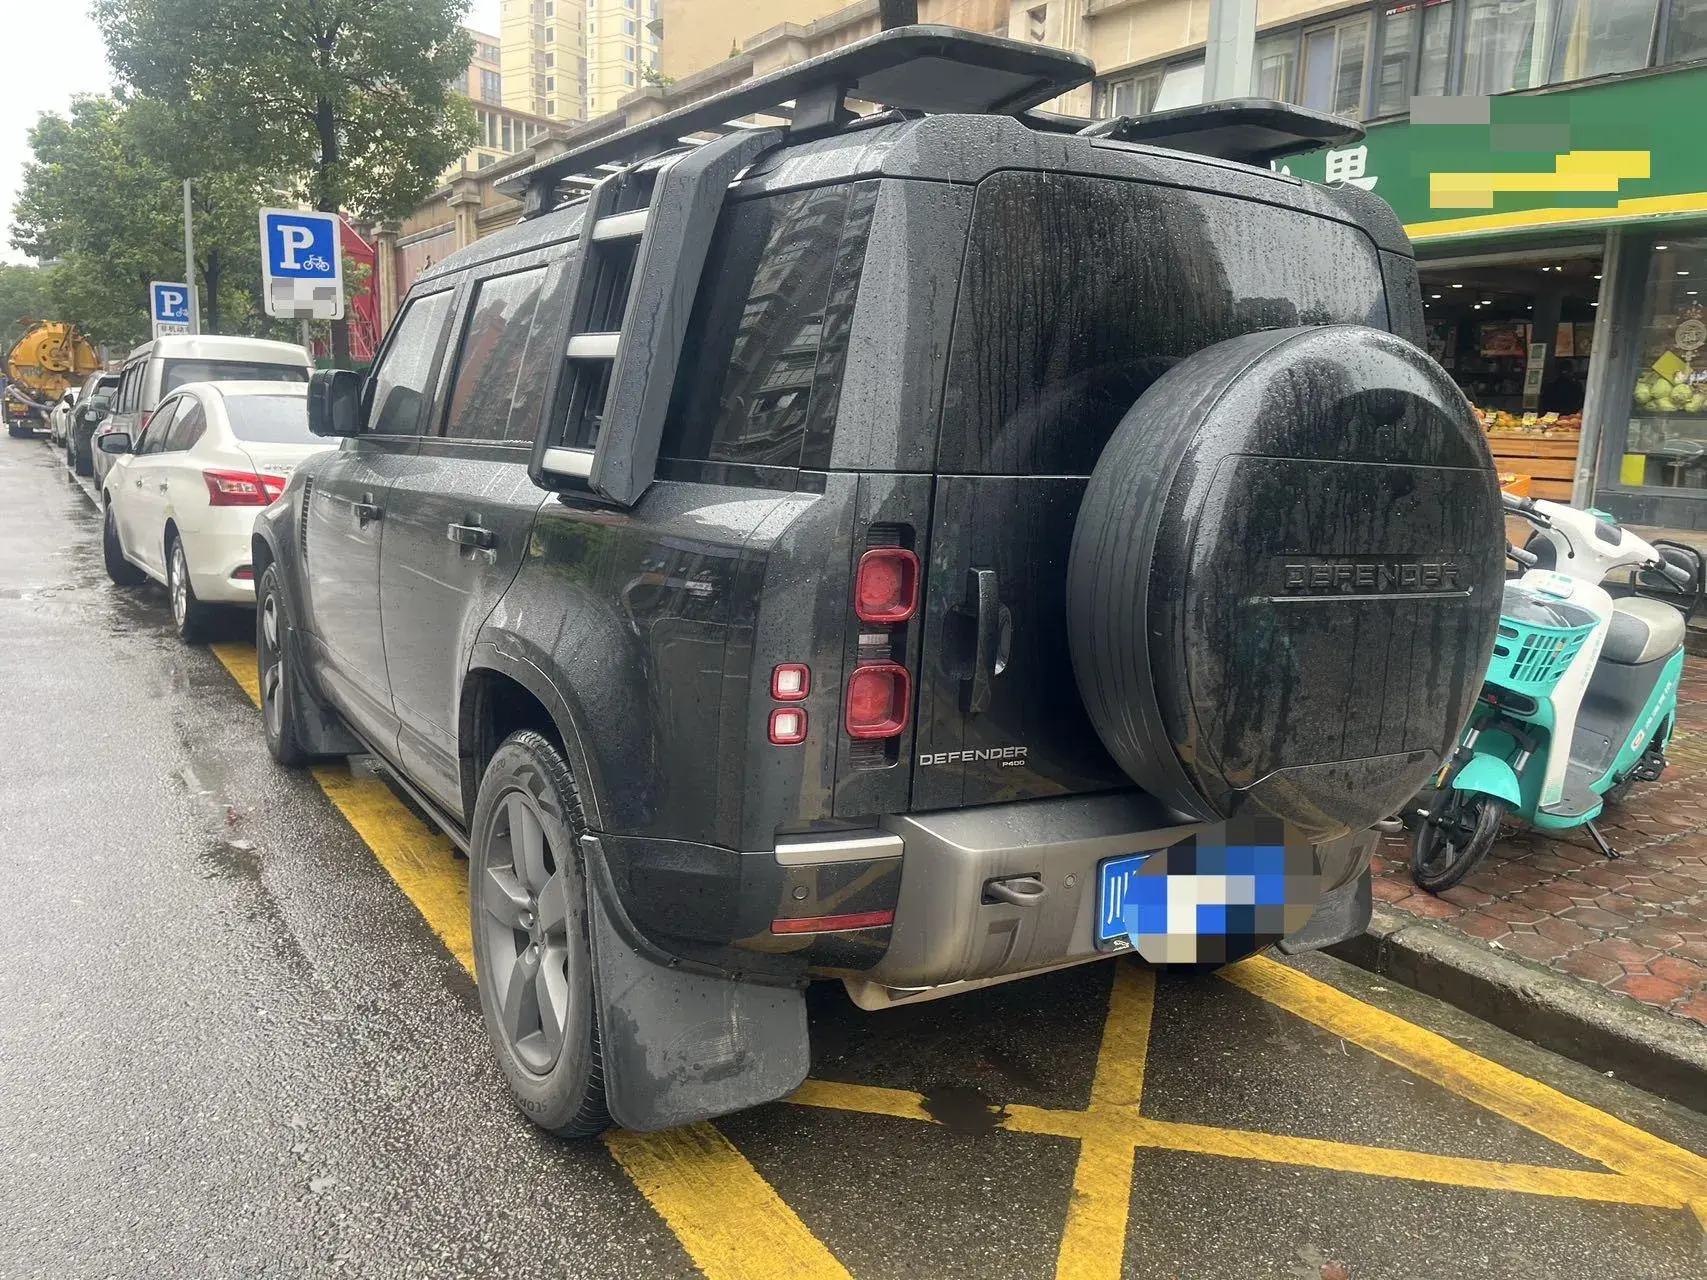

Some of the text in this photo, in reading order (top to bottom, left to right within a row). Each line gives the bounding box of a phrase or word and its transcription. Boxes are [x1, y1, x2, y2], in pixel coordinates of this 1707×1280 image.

[277, 225, 315, 270] P
[160, 290, 183, 317] P
[1284, 563, 1459, 589] DEFENDER
[919, 746, 1028, 766] DEFENDER
[1002, 760, 1025, 768] P400
